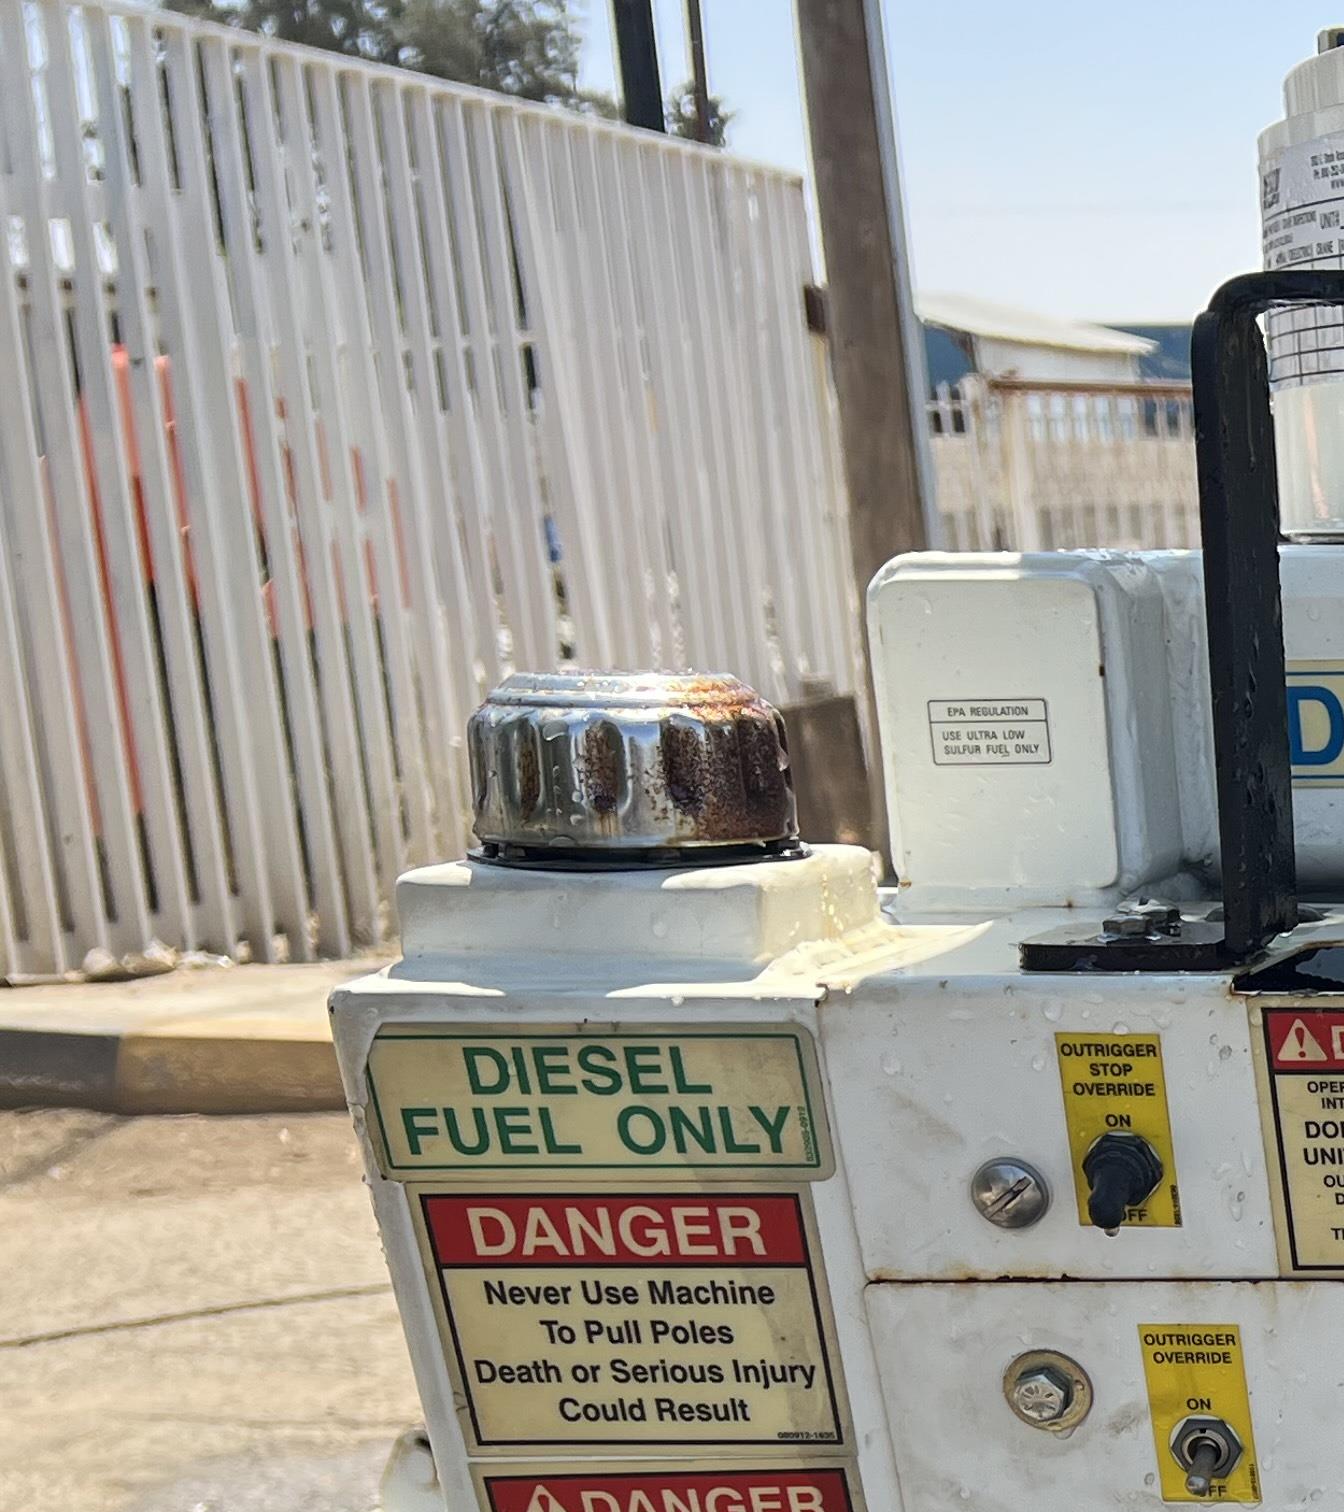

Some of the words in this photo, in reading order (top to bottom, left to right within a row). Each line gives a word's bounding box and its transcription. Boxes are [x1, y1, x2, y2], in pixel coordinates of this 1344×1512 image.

[947, 706, 966, 716] EPA
[969, 705, 1028, 716] REGULATION
[942, 730, 961, 740] USE
[966, 730, 997, 740] ULTRA
[1002, 729, 1025, 740] LOW
[943, 744, 981, 754] SULFUR
[985, 743, 1009, 755] FUEL
[1014, 743, 1039, 753] ONLY
[1060, 1042, 1156, 1057] OUTRIGGER
[461, 1044, 712, 1095] DIESEL
[1089, 1062, 1132, 1076] STOP
[1072, 1082, 1155, 1096] OVERRIDE
[1105, 1114, 1130, 1127] ON
[399, 1106, 582, 1155] FUEL
[617, 1105, 787, 1154] ONLY
[466, 1206, 766, 1256] DANGER
[483, 1280, 571, 1305] Never
[580, 1280, 639, 1304] Use
[647, 1279, 775, 1304] Machine
[538, 1319, 575, 1344] To
[583, 1319, 641, 1344] Pull
[649, 1319, 733, 1344] Poles
[1143, 1333, 1235, 1345] OUTRIGGER
[1153, 1351, 1231, 1363] OVERRIDE
[1186, 1398, 1211, 1410] ON
